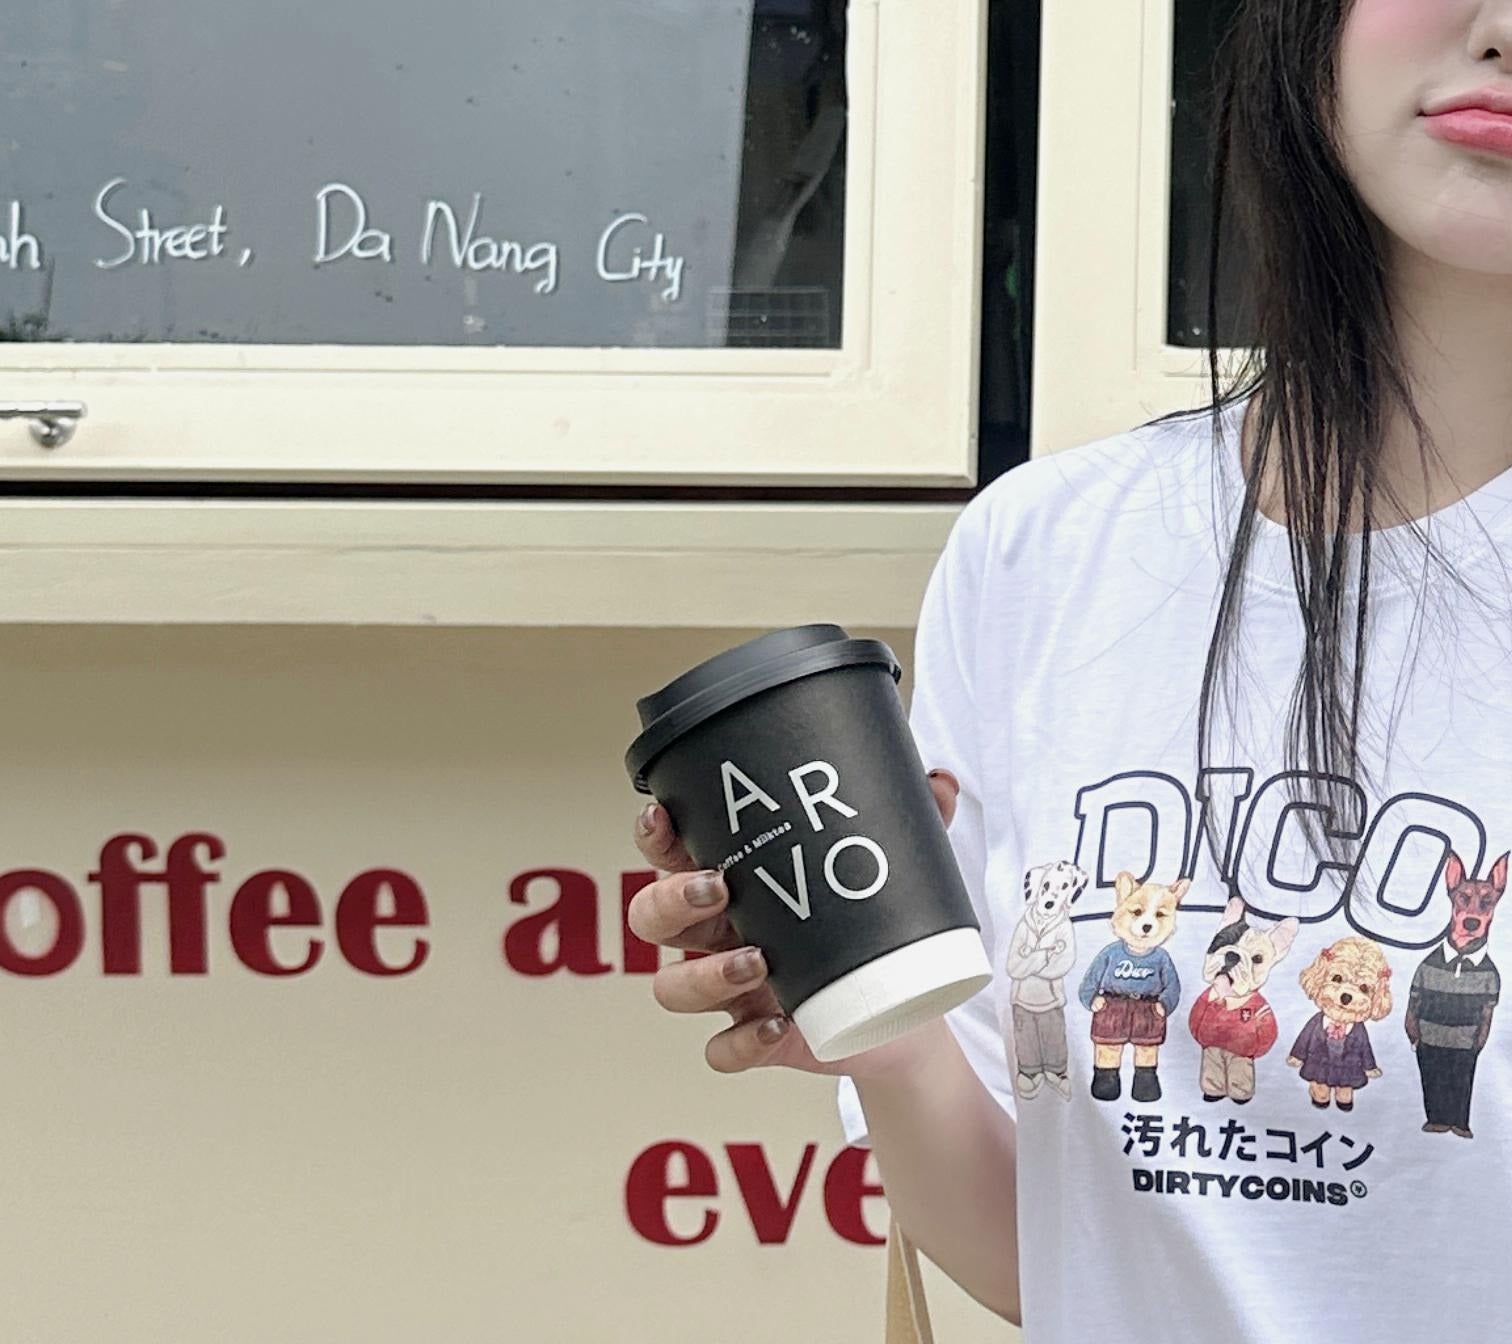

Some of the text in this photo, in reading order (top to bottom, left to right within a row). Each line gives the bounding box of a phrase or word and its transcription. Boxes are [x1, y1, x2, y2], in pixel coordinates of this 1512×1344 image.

[95, 177, 253, 268] Street,
[315, 183, 392, 263] Da
[421, 192, 558, 293] Nang
[597, 213, 686, 301] City
[1071, 767, 1487, 950] DICO
[624, 1139, 888, 1246] eve
[1121, 1112, 1374, 1171] 汚れたコイン
